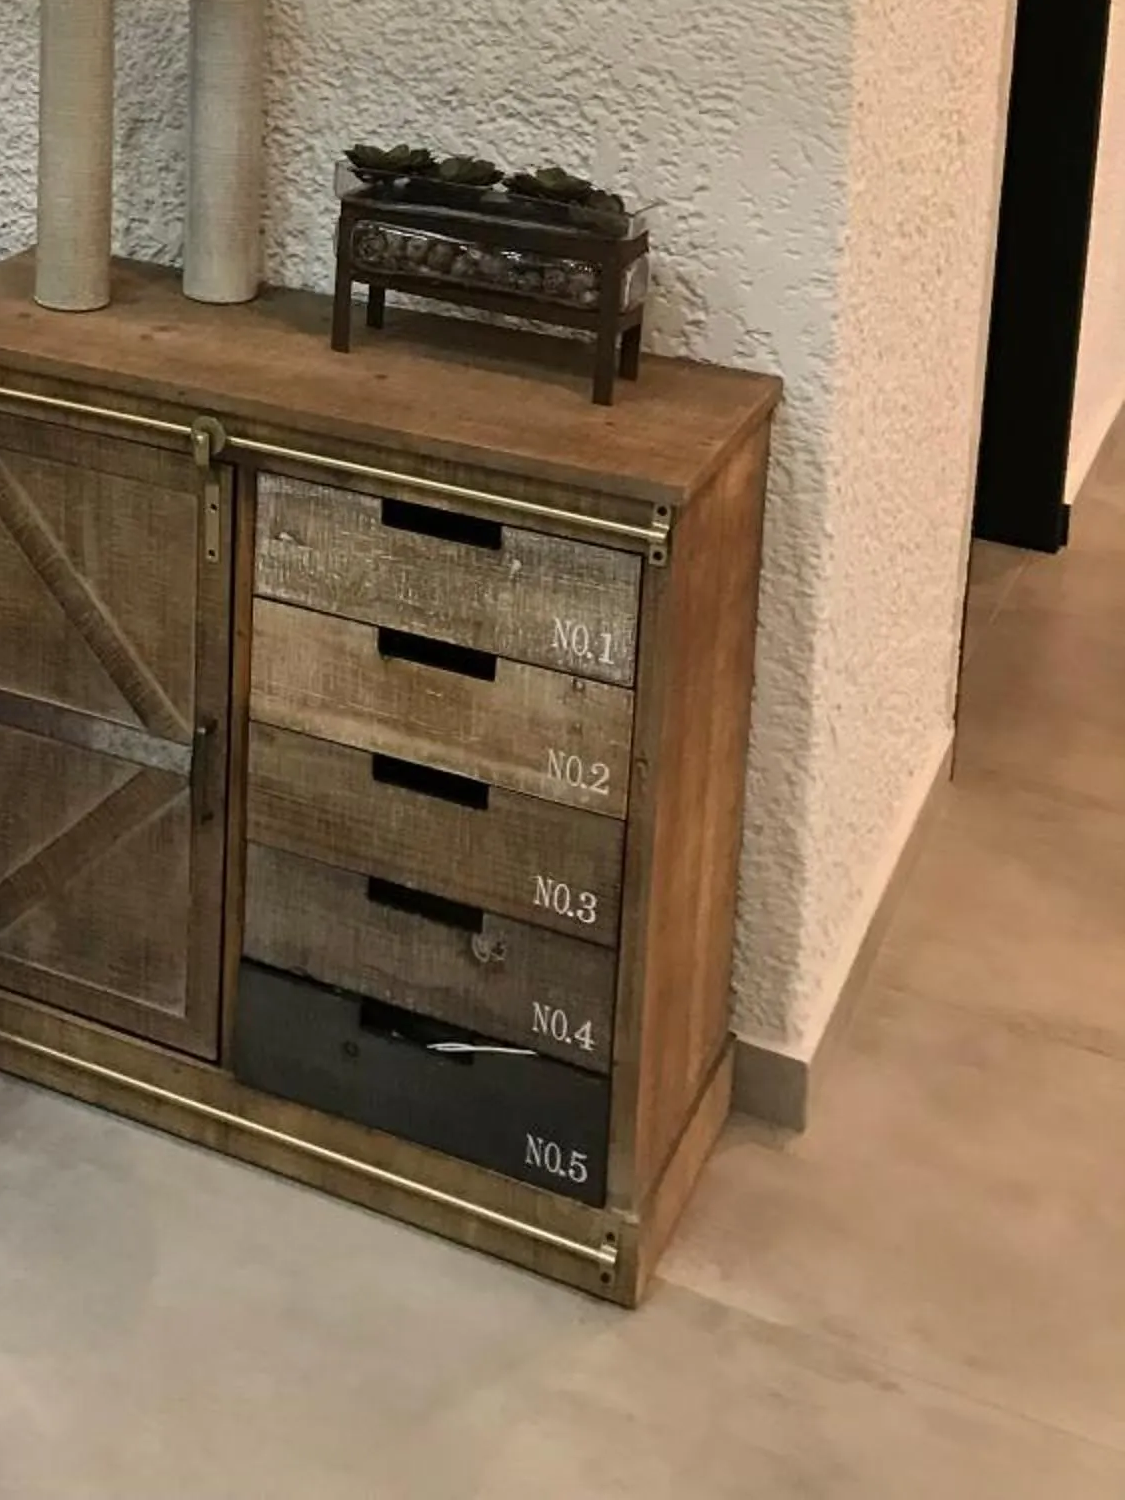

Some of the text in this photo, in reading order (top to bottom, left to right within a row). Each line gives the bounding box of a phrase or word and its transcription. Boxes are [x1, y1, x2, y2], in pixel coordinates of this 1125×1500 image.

[551, 618, 615, 665] NO.1
[547, 749, 610, 795] NO.2
[532, 875, 597, 925] NO.3
[531, 1001, 595, 1052] NO.4
[524, 1133, 588, 1184] NO.5
